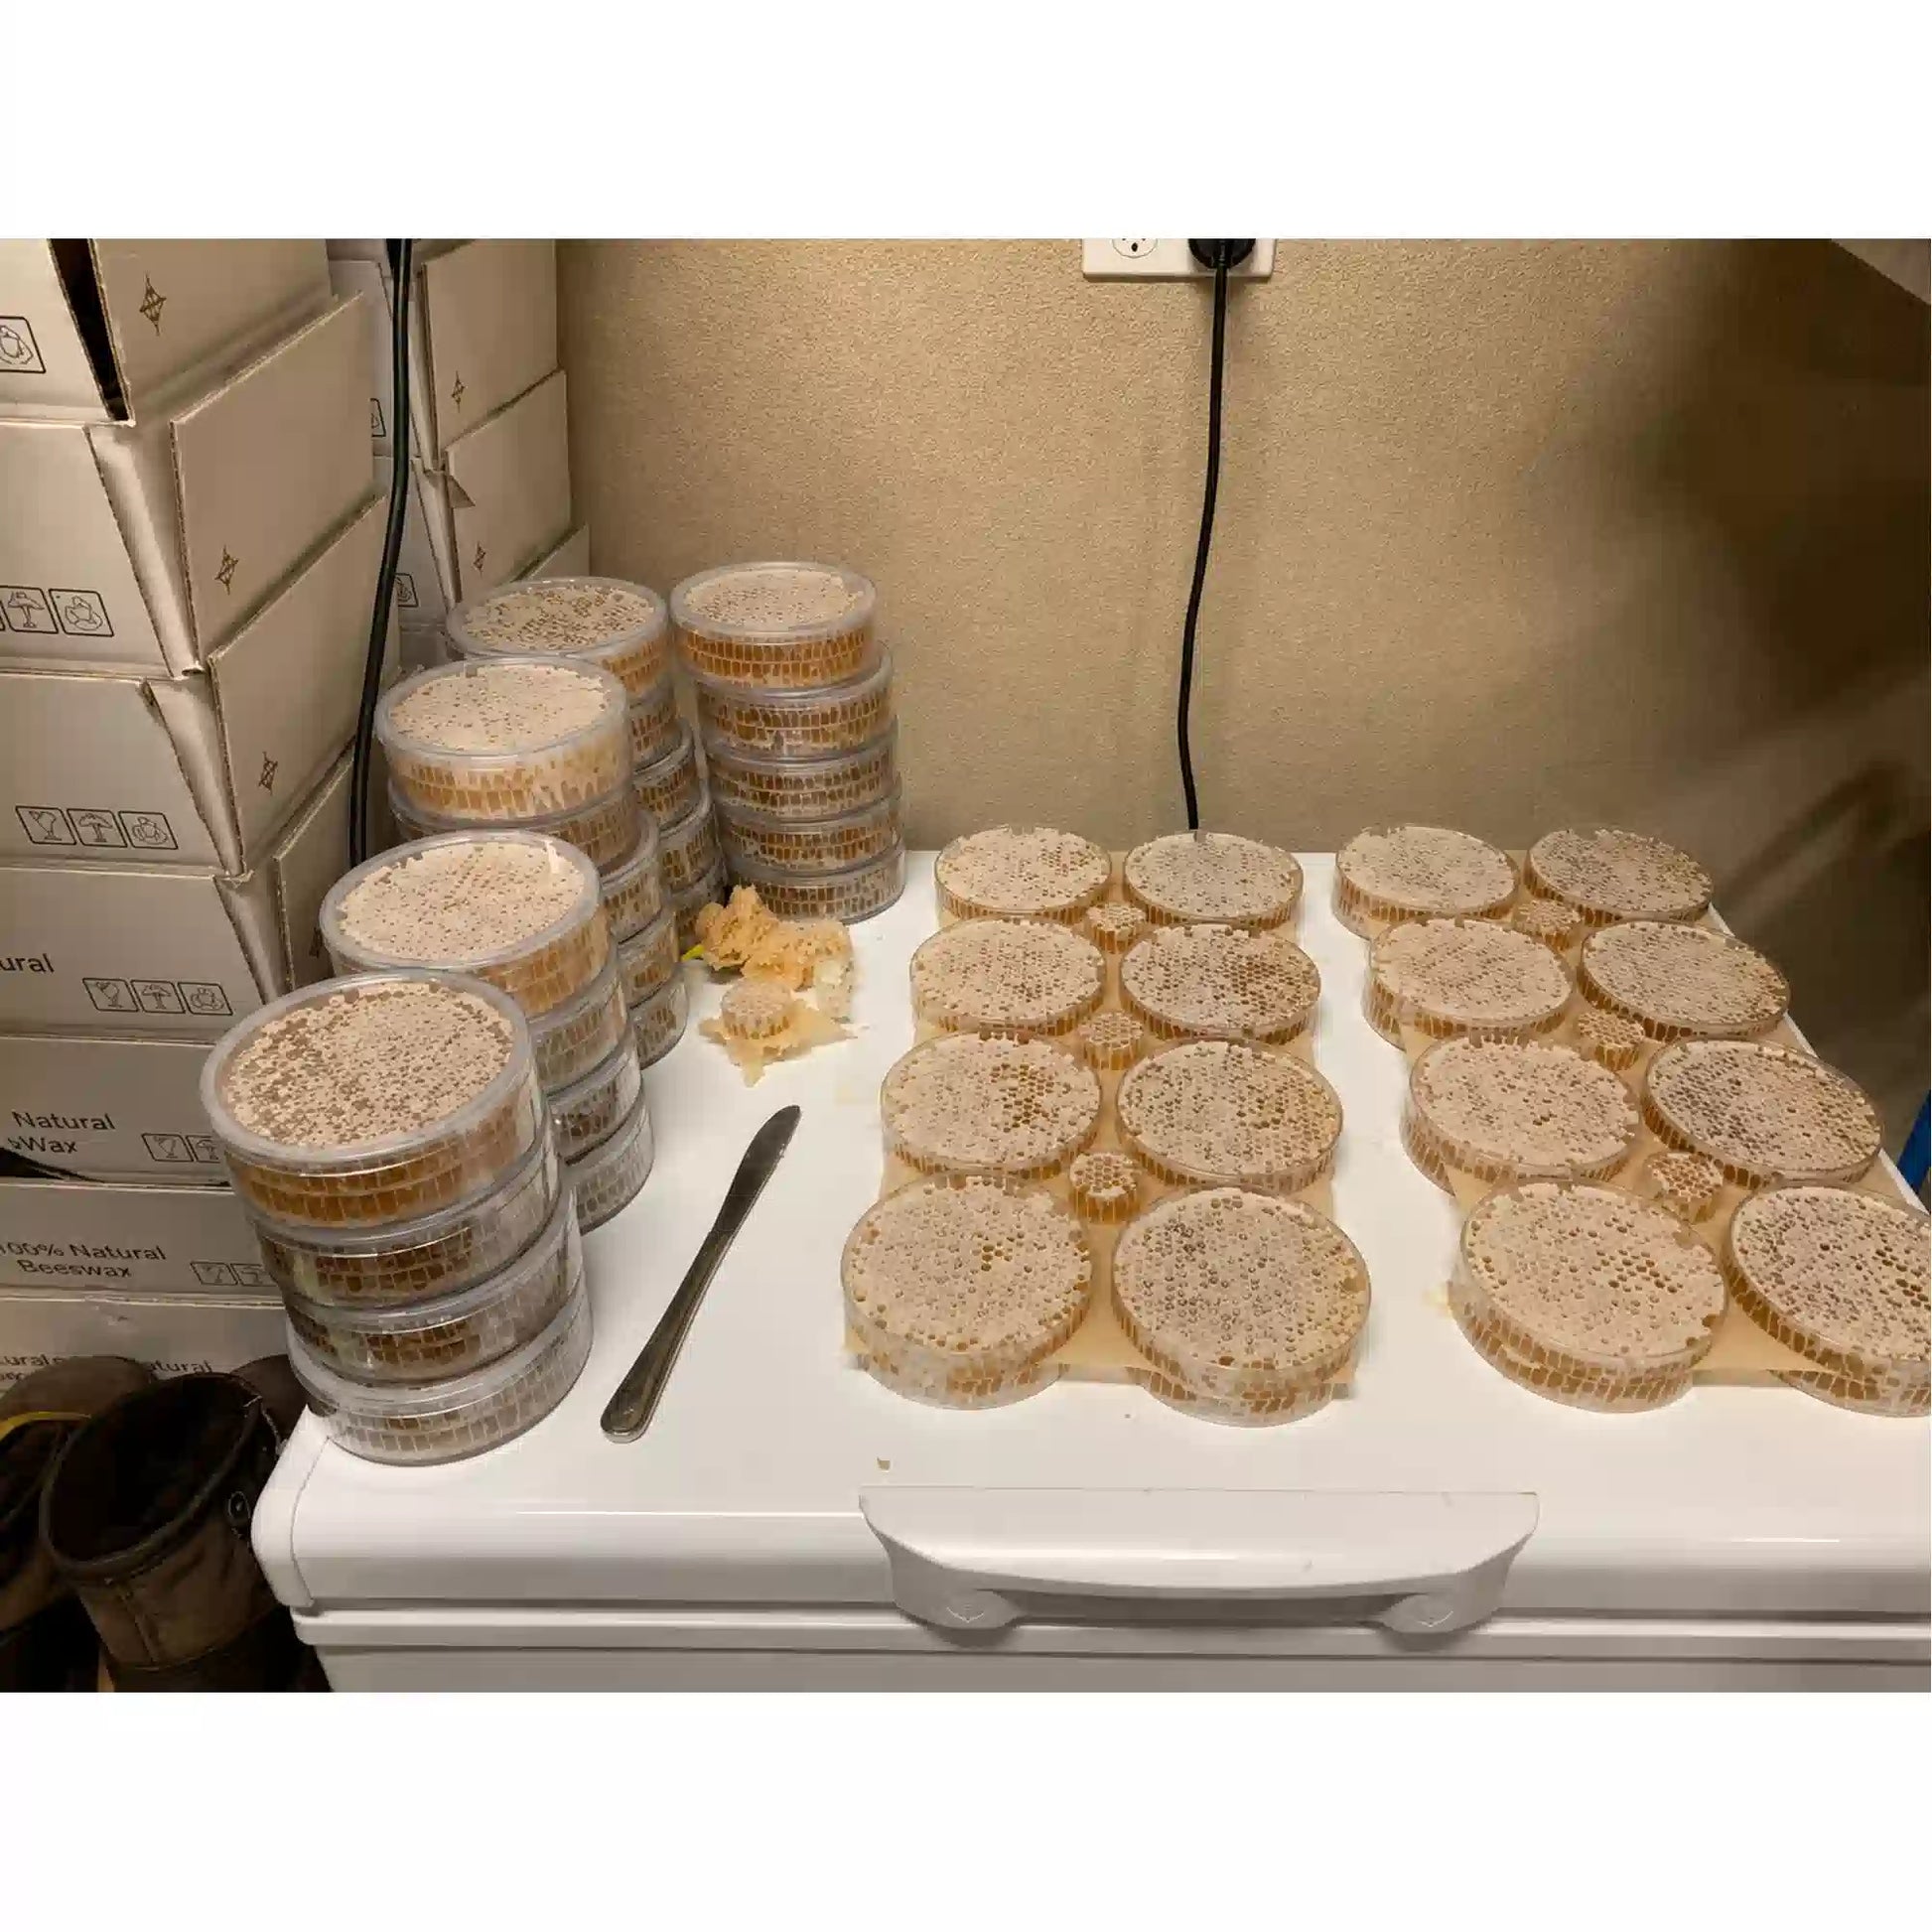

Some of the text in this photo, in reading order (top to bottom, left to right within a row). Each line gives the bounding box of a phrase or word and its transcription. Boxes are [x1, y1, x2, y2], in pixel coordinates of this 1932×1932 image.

[12, 1111, 116, 1130] Natural
[69, 1243, 167, 1260] Natural
[17, 1259, 132, 1278] Beeswax
